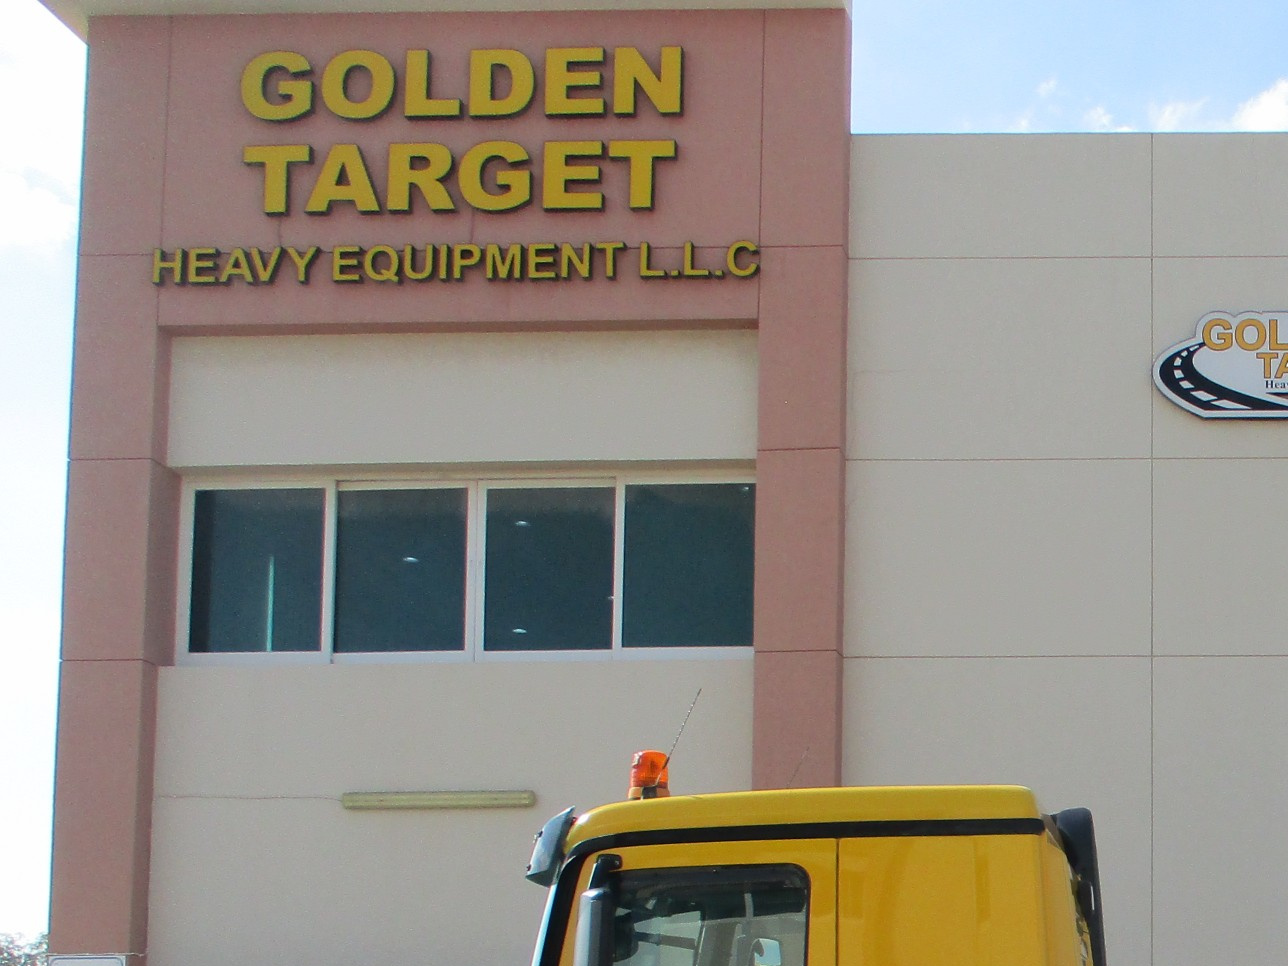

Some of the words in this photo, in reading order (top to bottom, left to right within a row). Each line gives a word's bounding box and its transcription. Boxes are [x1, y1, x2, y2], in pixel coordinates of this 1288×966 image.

[240, 46, 684, 120] GOLDEN
[243, 139, 677, 214] TARGET
[152, 246, 320, 285] HEAVY
[331, 242, 625, 285] EQUIPMENT
[639, 240, 761, 280] L.L.C
